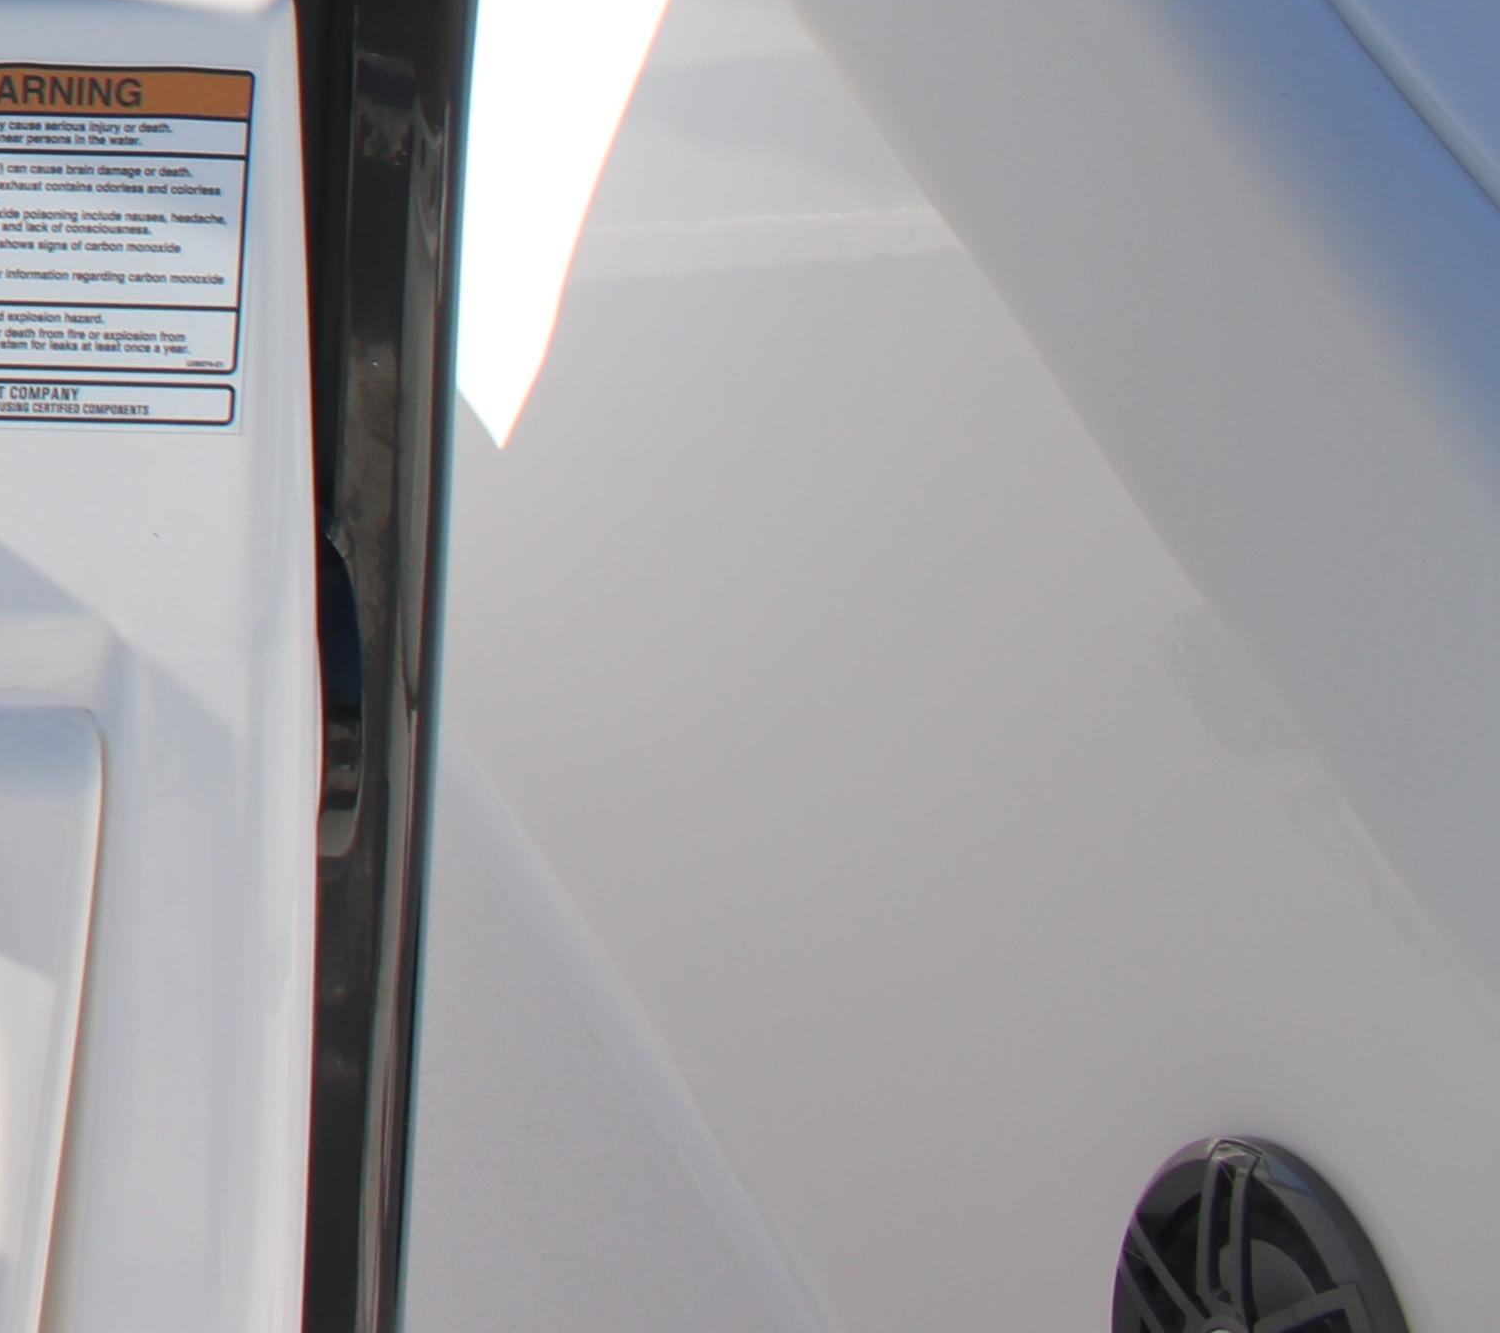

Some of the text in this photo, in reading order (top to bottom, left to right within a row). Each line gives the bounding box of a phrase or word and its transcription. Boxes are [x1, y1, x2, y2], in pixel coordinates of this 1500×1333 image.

[7, 122, 42, 132] cause
[44, 121, 86, 133] serious
[88, 122, 121, 136] injury
[123, 124, 136, 133] or
[137, 122, 172, 134] death.
[6, 164, 27, 173] can
[29, 165, 63, 175] cause
[65, 164, 95, 175] brain
[96, 164, 142, 179] damage
[143, 167, 155, 177] or
[156, 165, 193, 178] death.
[9, 385, 78, 401] COMPANY
[0, 401, 29, 413] USING
[31, 402, 80, 414] CERTIFIED
[82, 403, 149, 415] COMPONENTS
